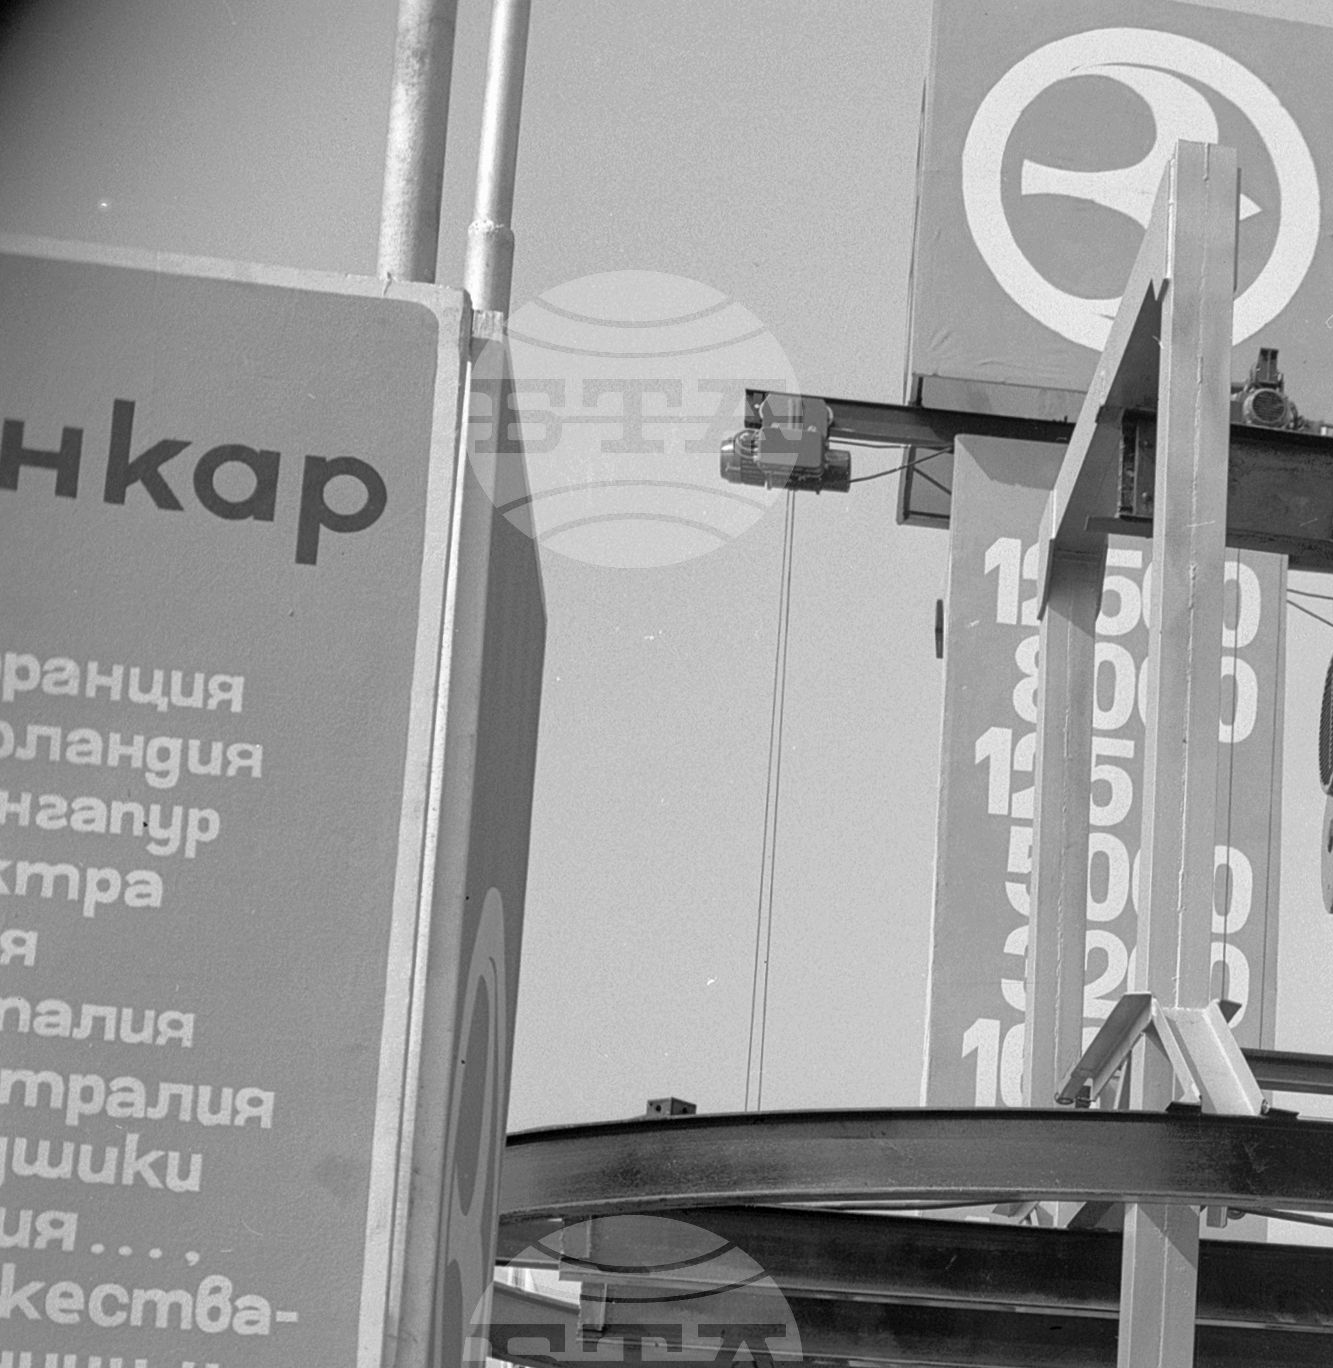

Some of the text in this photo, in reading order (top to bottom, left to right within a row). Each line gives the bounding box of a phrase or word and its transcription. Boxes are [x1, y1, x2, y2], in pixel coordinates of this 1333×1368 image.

[0, 398, 388, 566] нкар
[984, 537, 1261, 648] 150
[2, 652, 245, 713] ранция
[0, 790, 220, 858] нгапур
[1005, 825, 1253, 933] 500
[0, 929, 38, 966] я
[0, 1068, 275, 1128] тралия
[0, 1132, 203, 1193] шики
